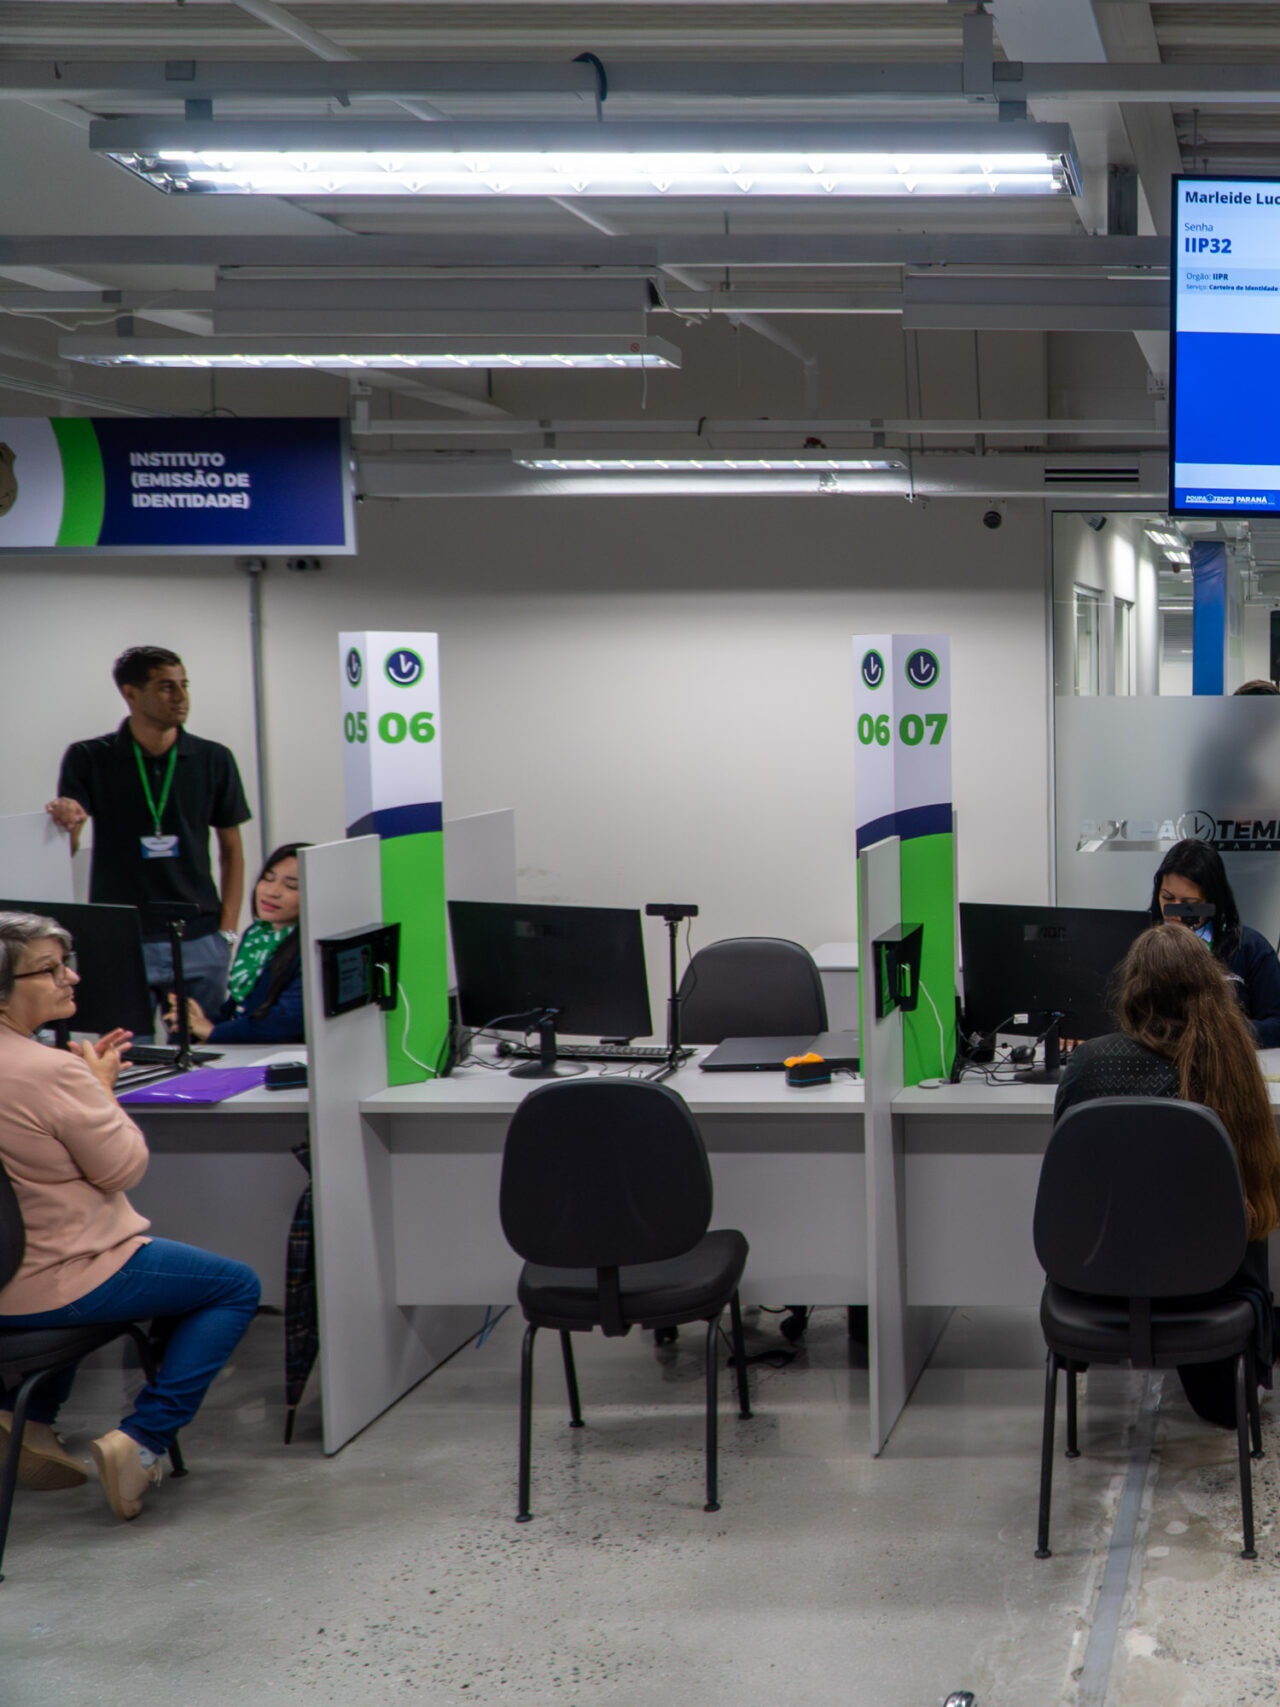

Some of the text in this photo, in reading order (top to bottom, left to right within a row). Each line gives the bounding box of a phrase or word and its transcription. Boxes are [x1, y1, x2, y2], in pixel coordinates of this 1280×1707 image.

[1186, 191, 1251, 204] Marleide
[1185, 223, 1213, 231] Senha
[1185, 238, 1231, 253] IIP32
[130, 453, 225, 467] INSTITUTO
[132, 470, 250, 488] (EMISSÃO DE
[133, 492, 250, 509] IDENTIDADE)
[344, 711, 368, 744] 05
[378, 711, 436, 744] 06
[858, 713, 890, 746] 06
[899, 713, 948, 746] 07
